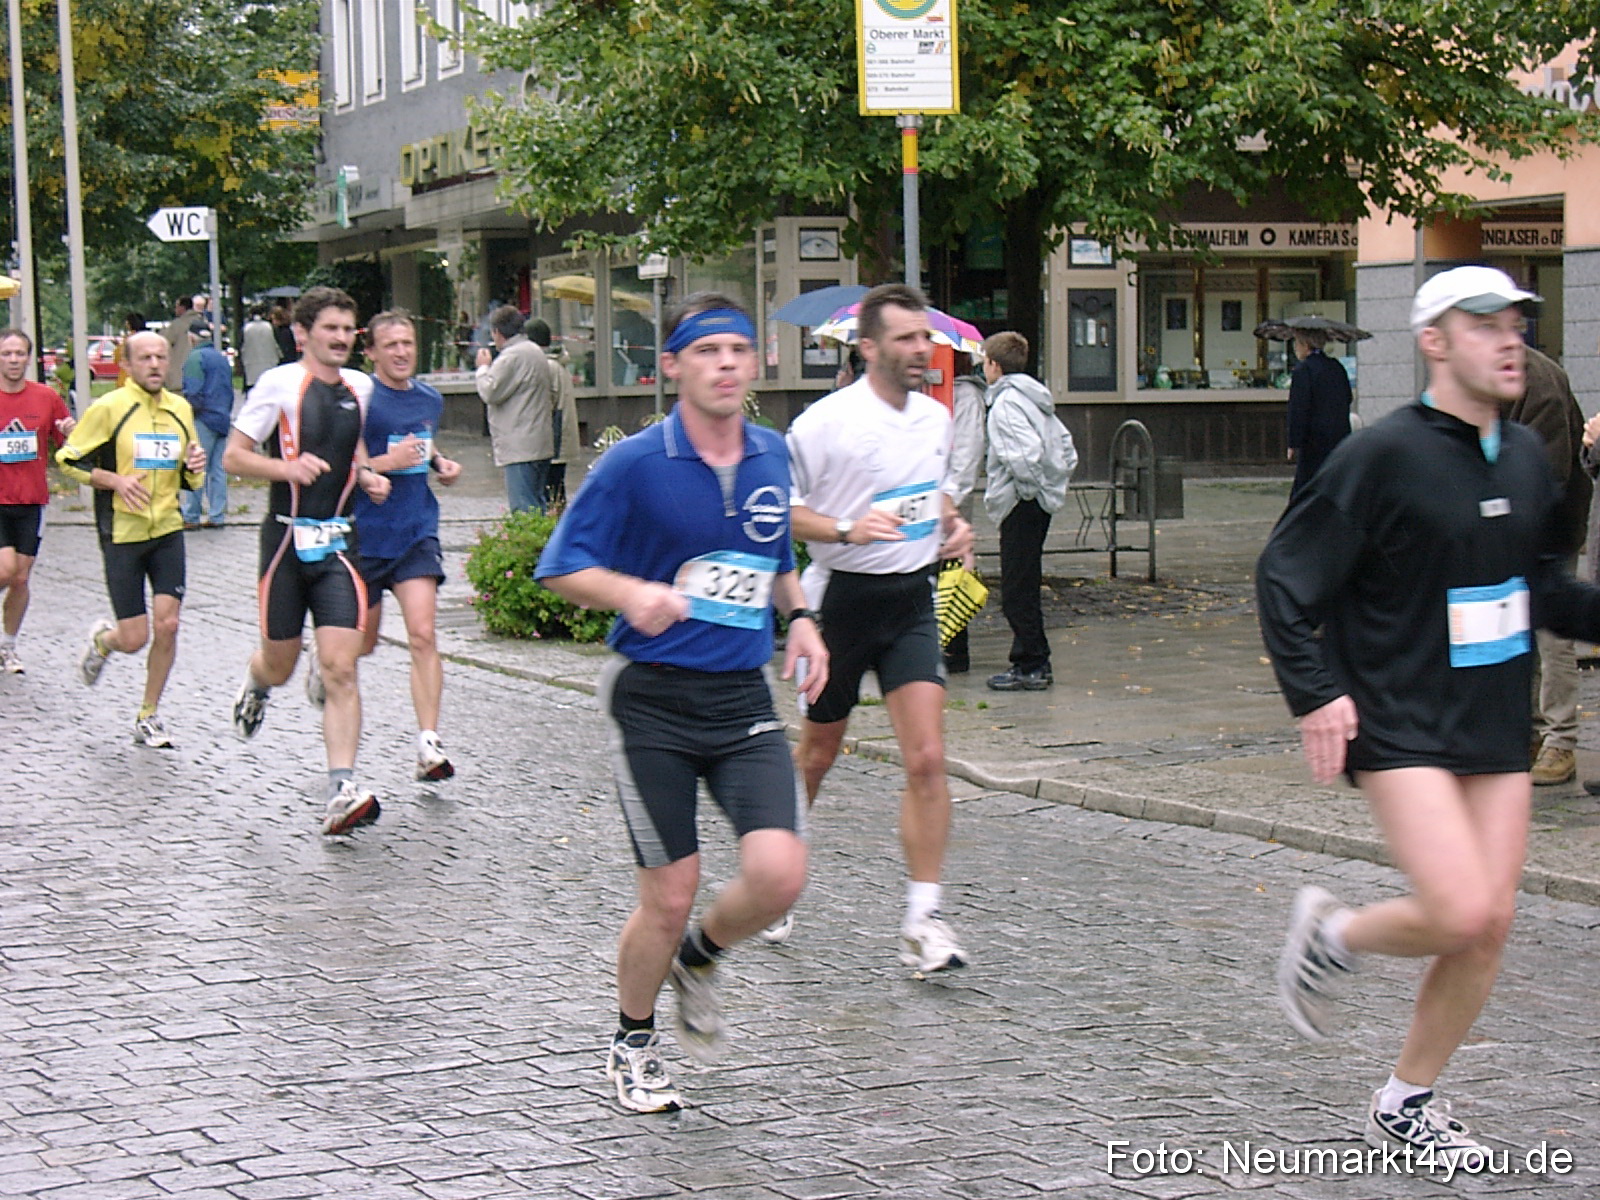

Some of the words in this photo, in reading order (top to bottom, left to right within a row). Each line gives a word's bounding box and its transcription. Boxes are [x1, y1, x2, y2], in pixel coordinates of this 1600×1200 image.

[869, 29, 909, 39] Oberer
[913, 29, 944, 39] Markt
[166, 212, 201, 237] WC
[7, 440, 29, 454] 596
[154, 441, 170, 458] 75
[704, 566, 758, 603] 329
